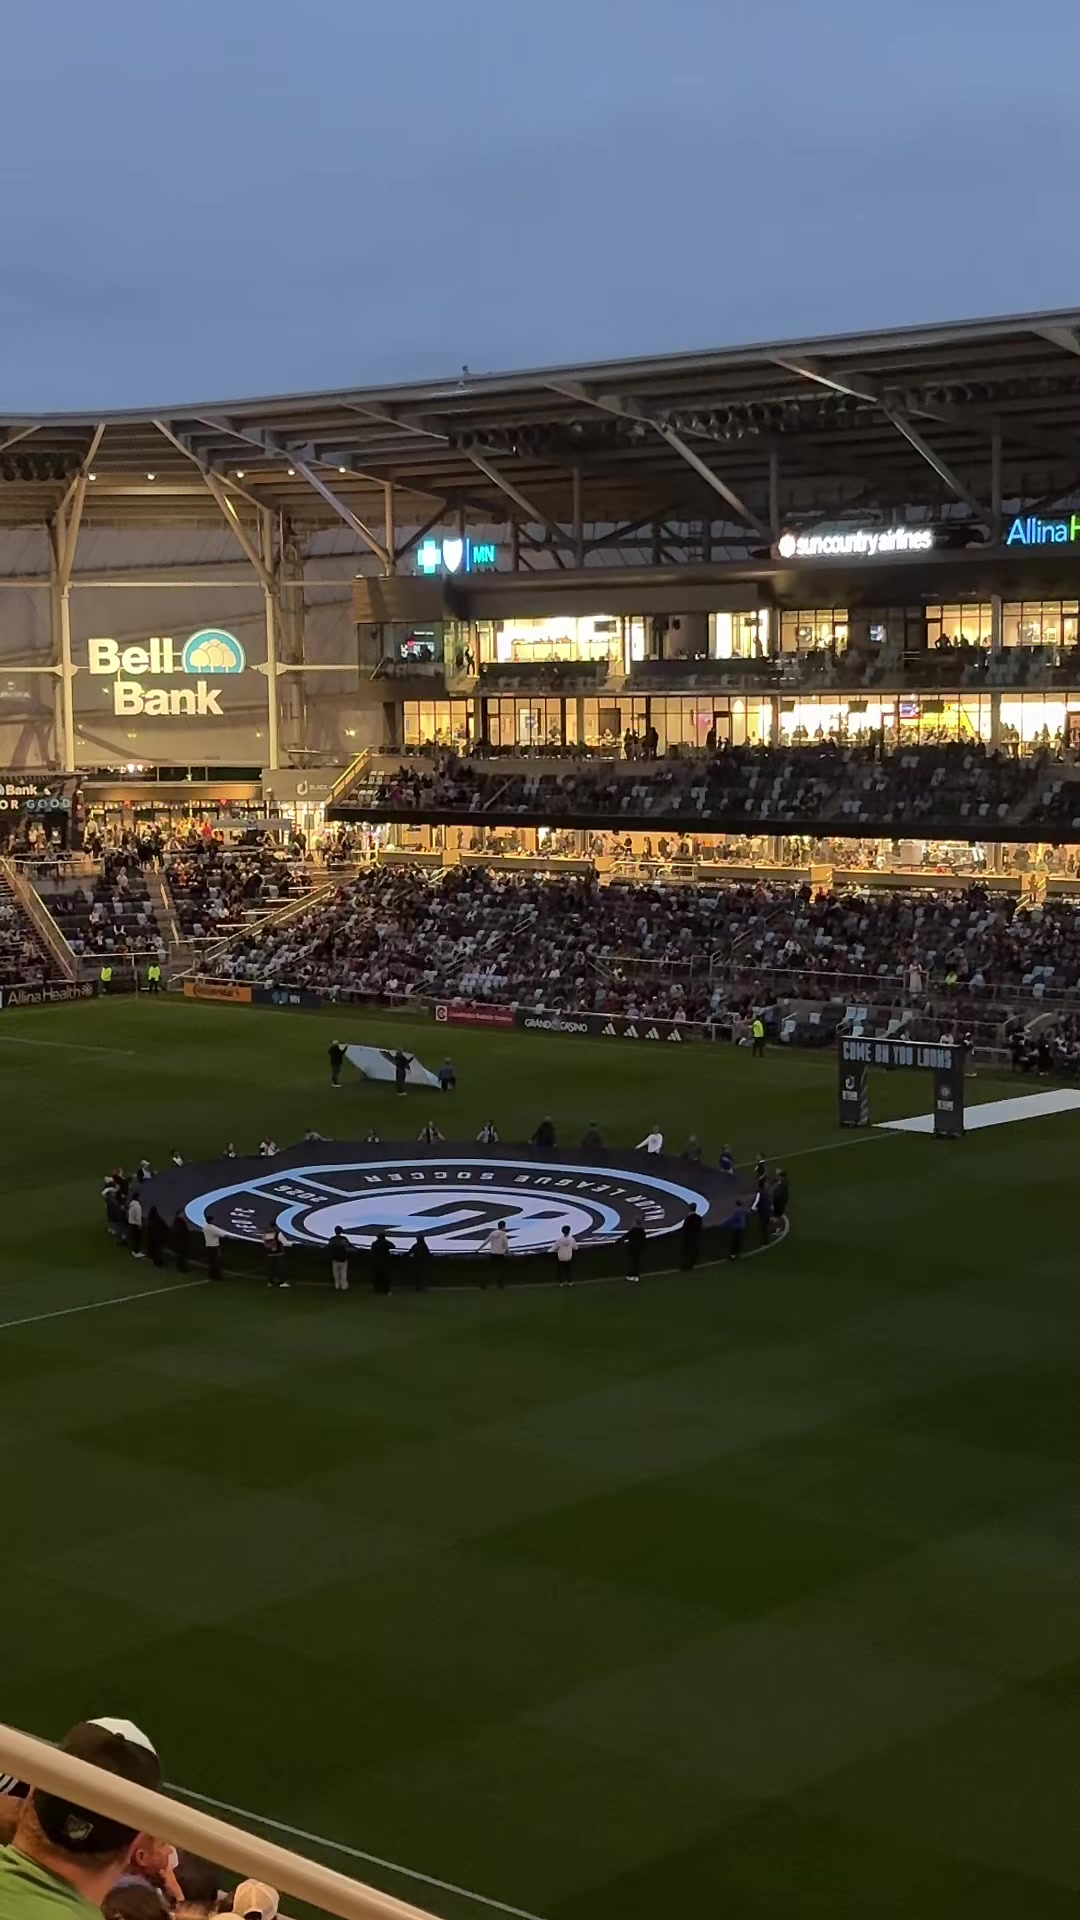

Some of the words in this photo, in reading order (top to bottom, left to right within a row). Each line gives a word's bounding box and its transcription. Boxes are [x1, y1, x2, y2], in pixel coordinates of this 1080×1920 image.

[473, 545, 495, 564] MN
[88, 637, 174, 674] Bell
[114, 680, 224, 716] Bank
[5, 783, 38, 796] Bank
[26, 798, 71, 810] GOOD
[524, 1018, 552, 1030] GRAND
[560, 1021, 588, 1033] CASINO
[843, 1040, 872, 1063] COME
[874, 1043, 890, 1064] ON
[893, 1045, 914, 1066] YOU
[917, 1047, 952, 1070] LOONS
[363, 1170, 496, 1184] SOCCER
[513, 1174, 627, 1197] LEAGUE
[273, 1184, 329, 1204] 2026
[625, 1193, 666, 1222] MAJOR
